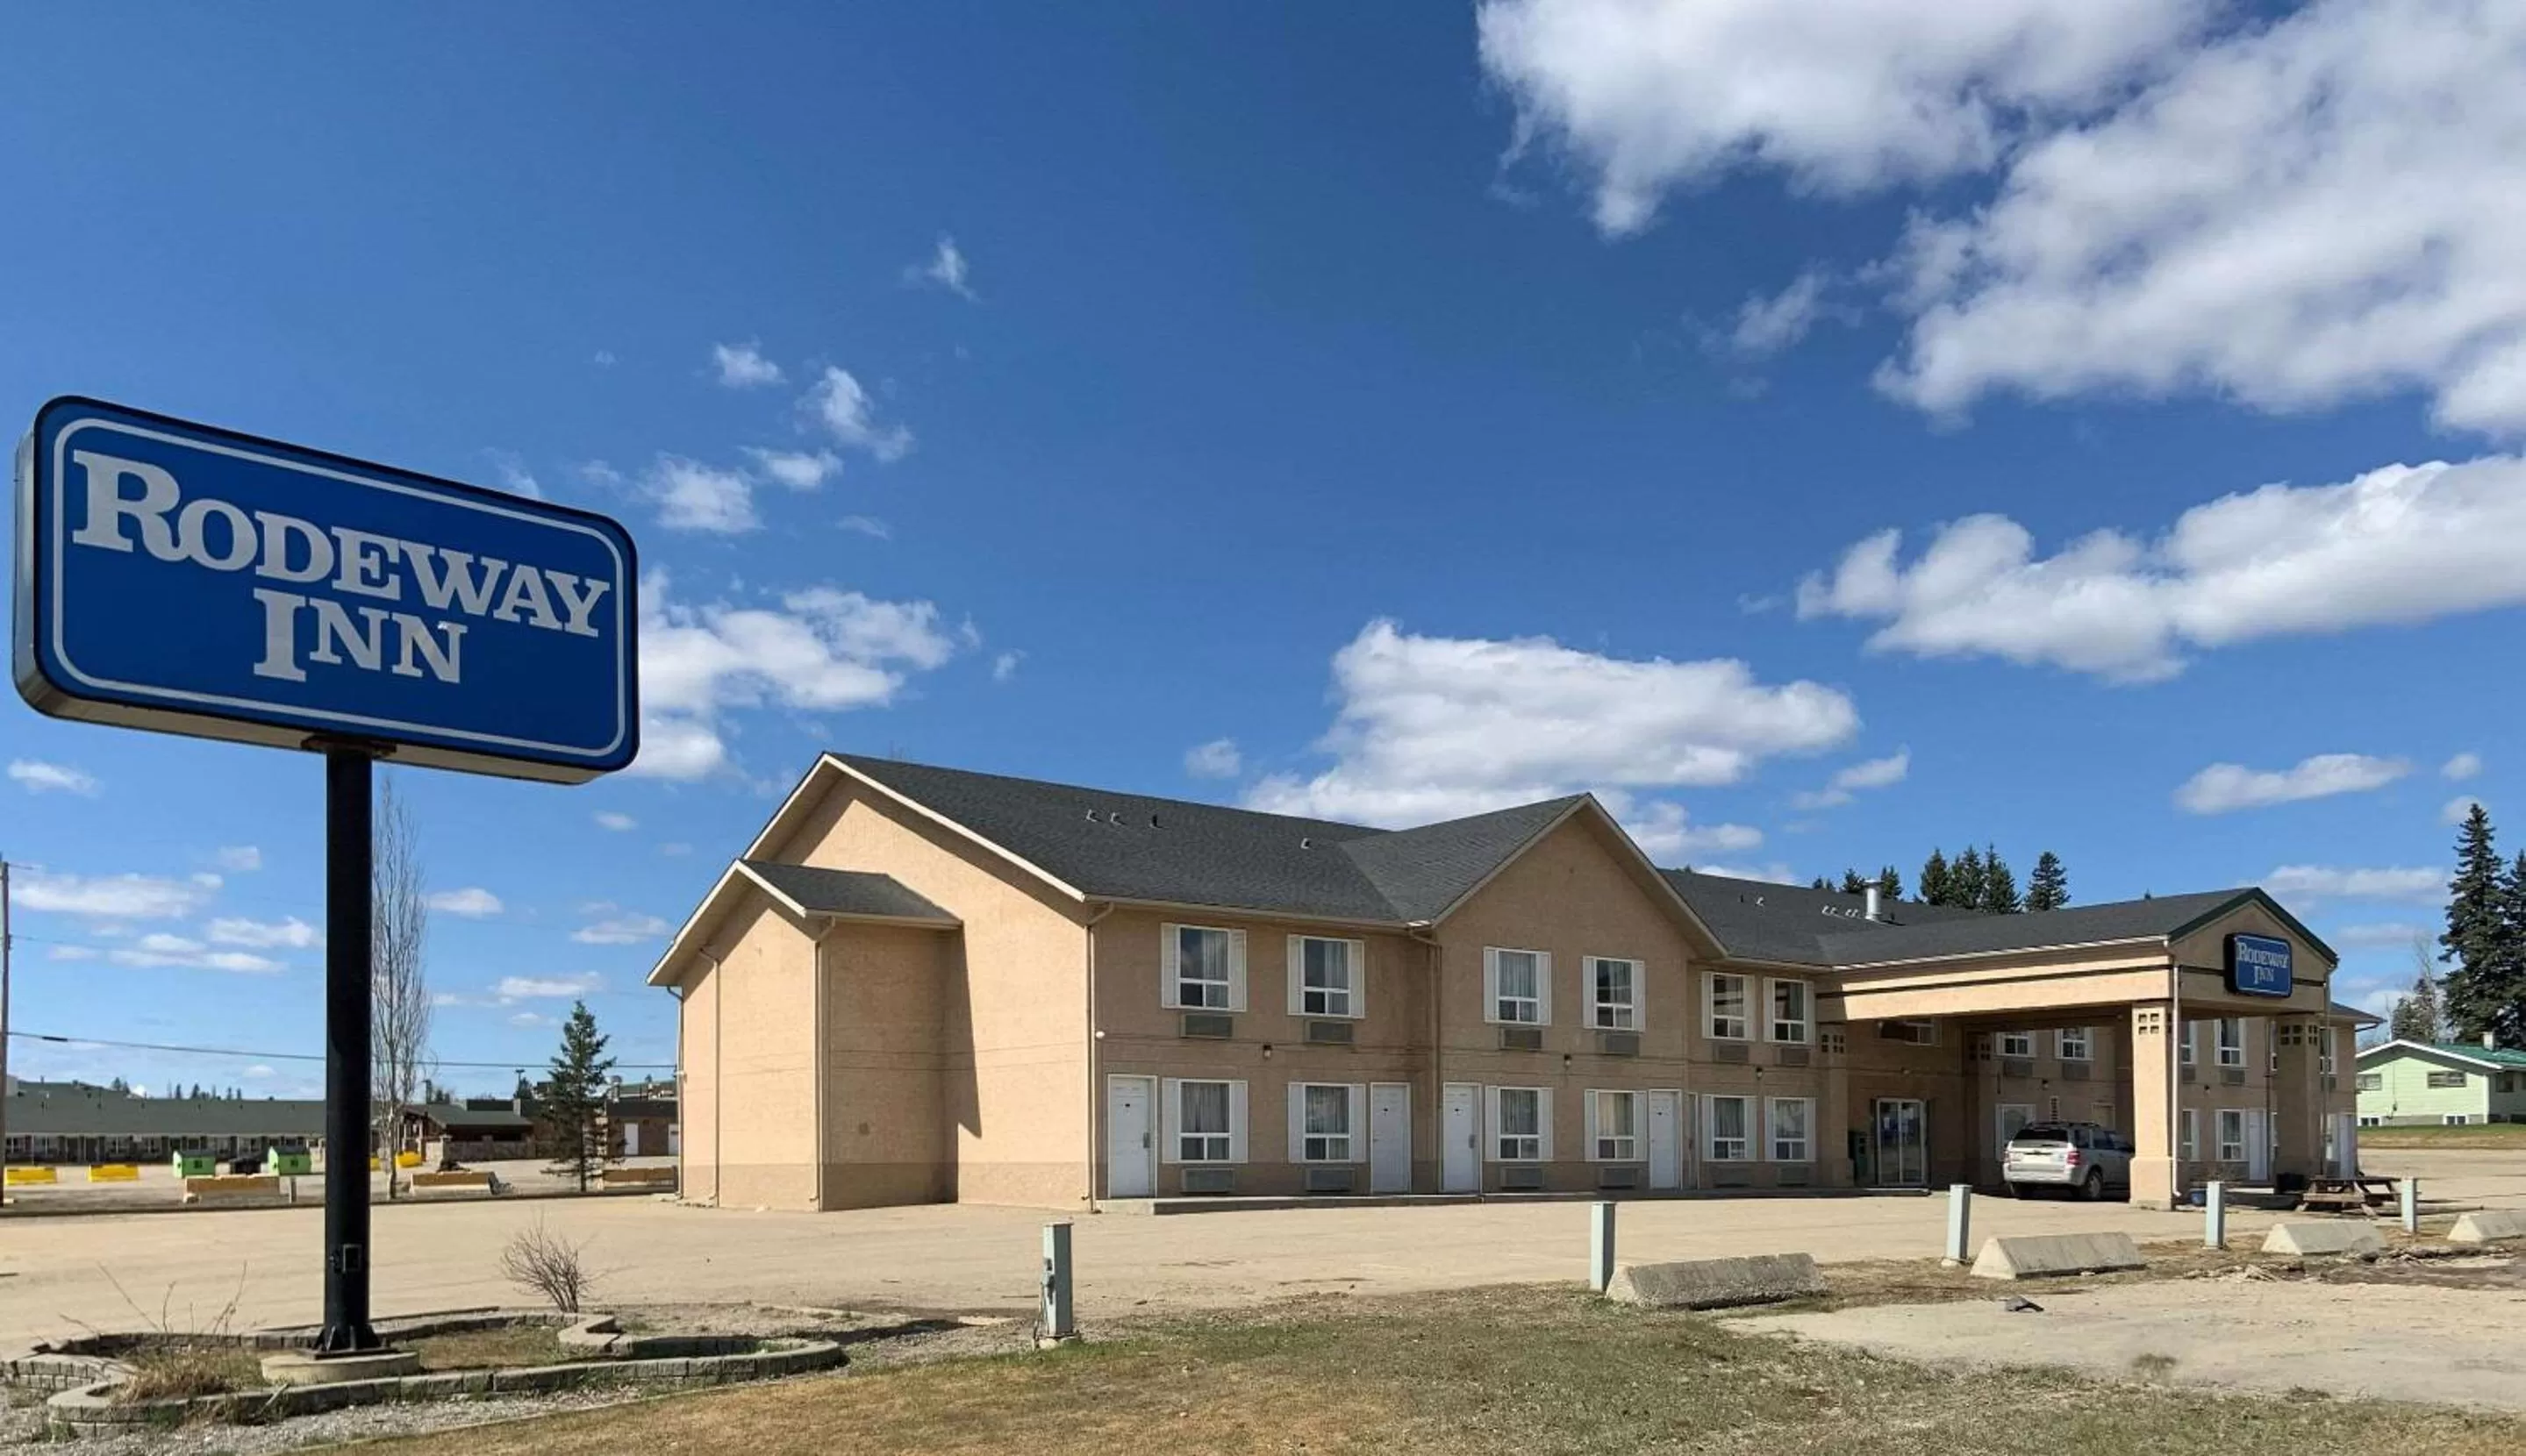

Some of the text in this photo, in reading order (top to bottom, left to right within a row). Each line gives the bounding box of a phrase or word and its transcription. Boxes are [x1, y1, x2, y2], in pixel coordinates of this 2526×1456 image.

[73, 449, 610, 638] RODEWAY
[253, 589, 468, 684] INN
[2236, 942, 2288, 968] RODEWAY
[2253, 966, 2274, 984] INN
